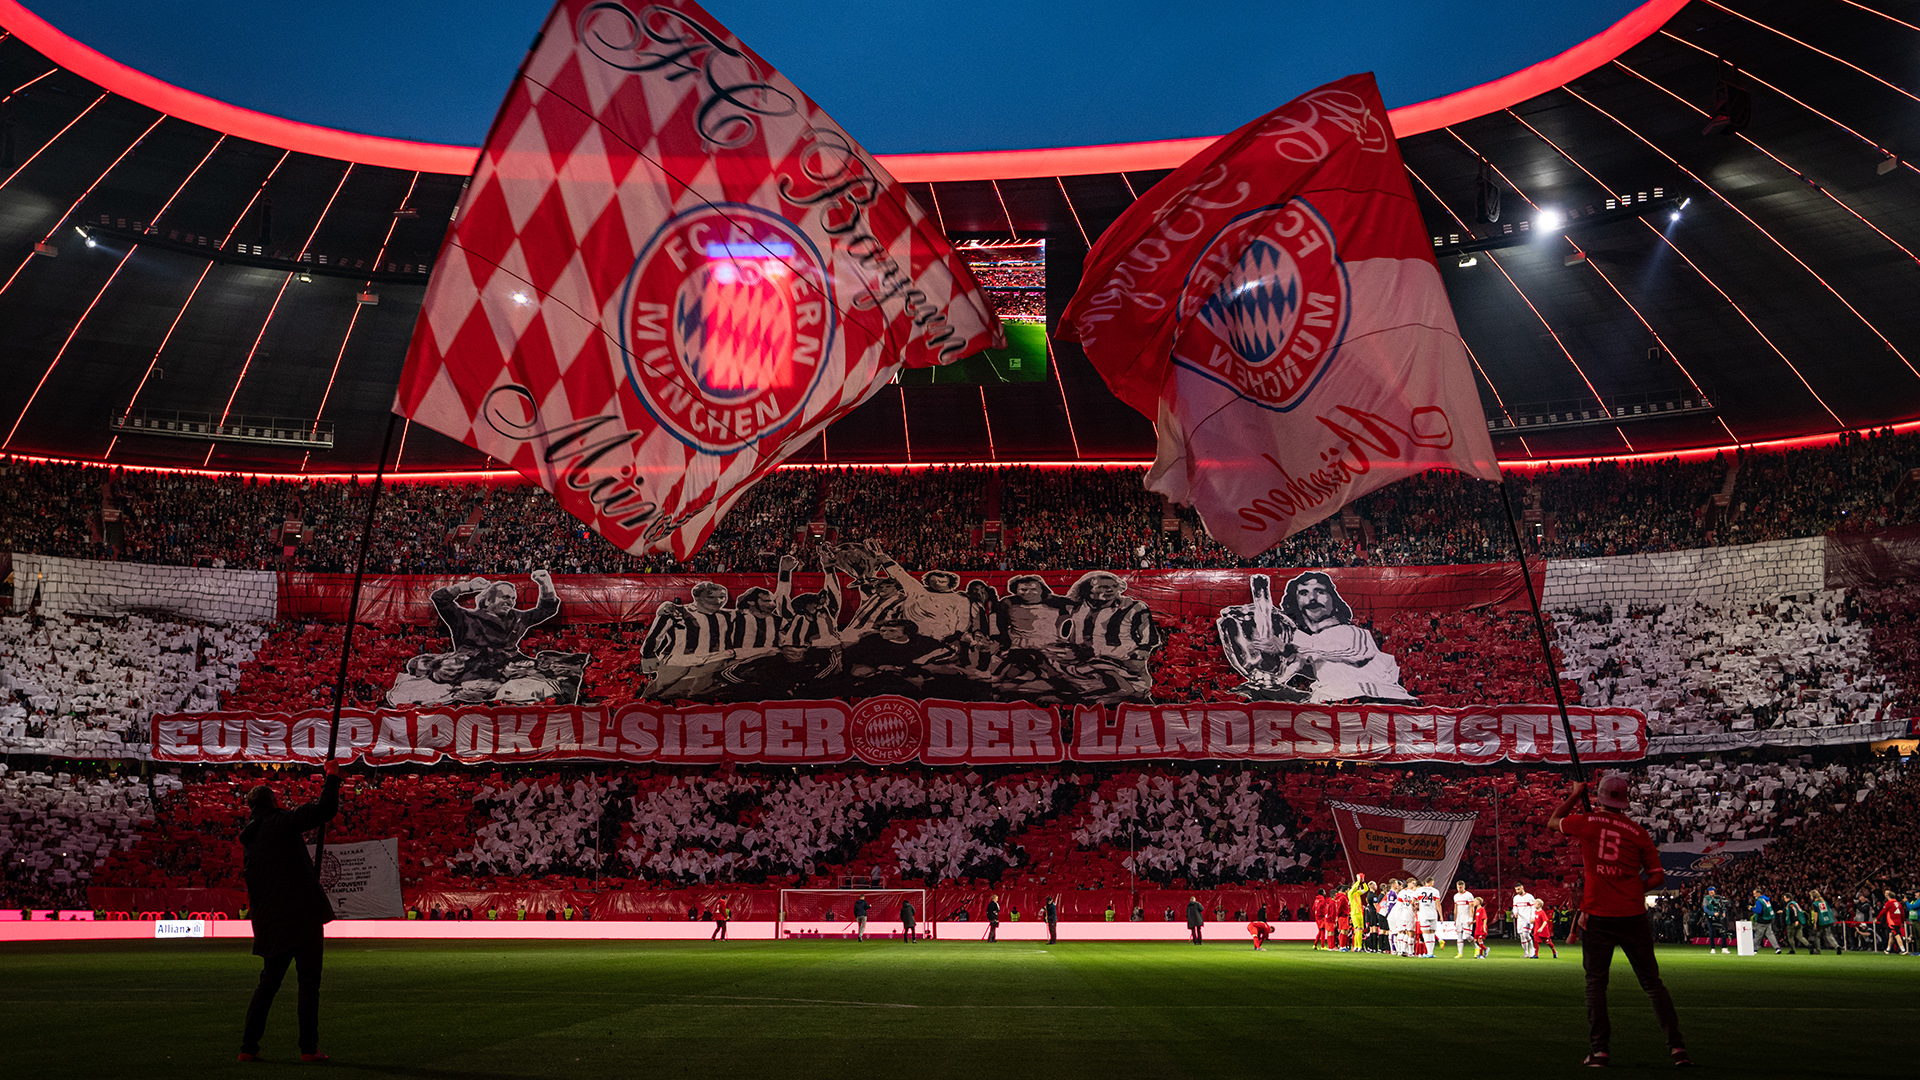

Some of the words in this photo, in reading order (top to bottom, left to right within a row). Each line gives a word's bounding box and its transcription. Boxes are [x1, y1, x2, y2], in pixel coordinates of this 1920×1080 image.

[637, 301, 782, 440] MÜNCHEN
[873, 703, 917, 725] BAYERN
[158, 707, 847, 757] EUROPAPOKALSIEGER
[927, 707, 1060, 757] DER
[1076, 709, 1638, 757] LANDESMEISTER
[1367, 843, 1380, 852] der
[1598, 828, 1620, 860] 13
[338, 898, 347, 908] F
[1421, 891, 1434, 903] 24
